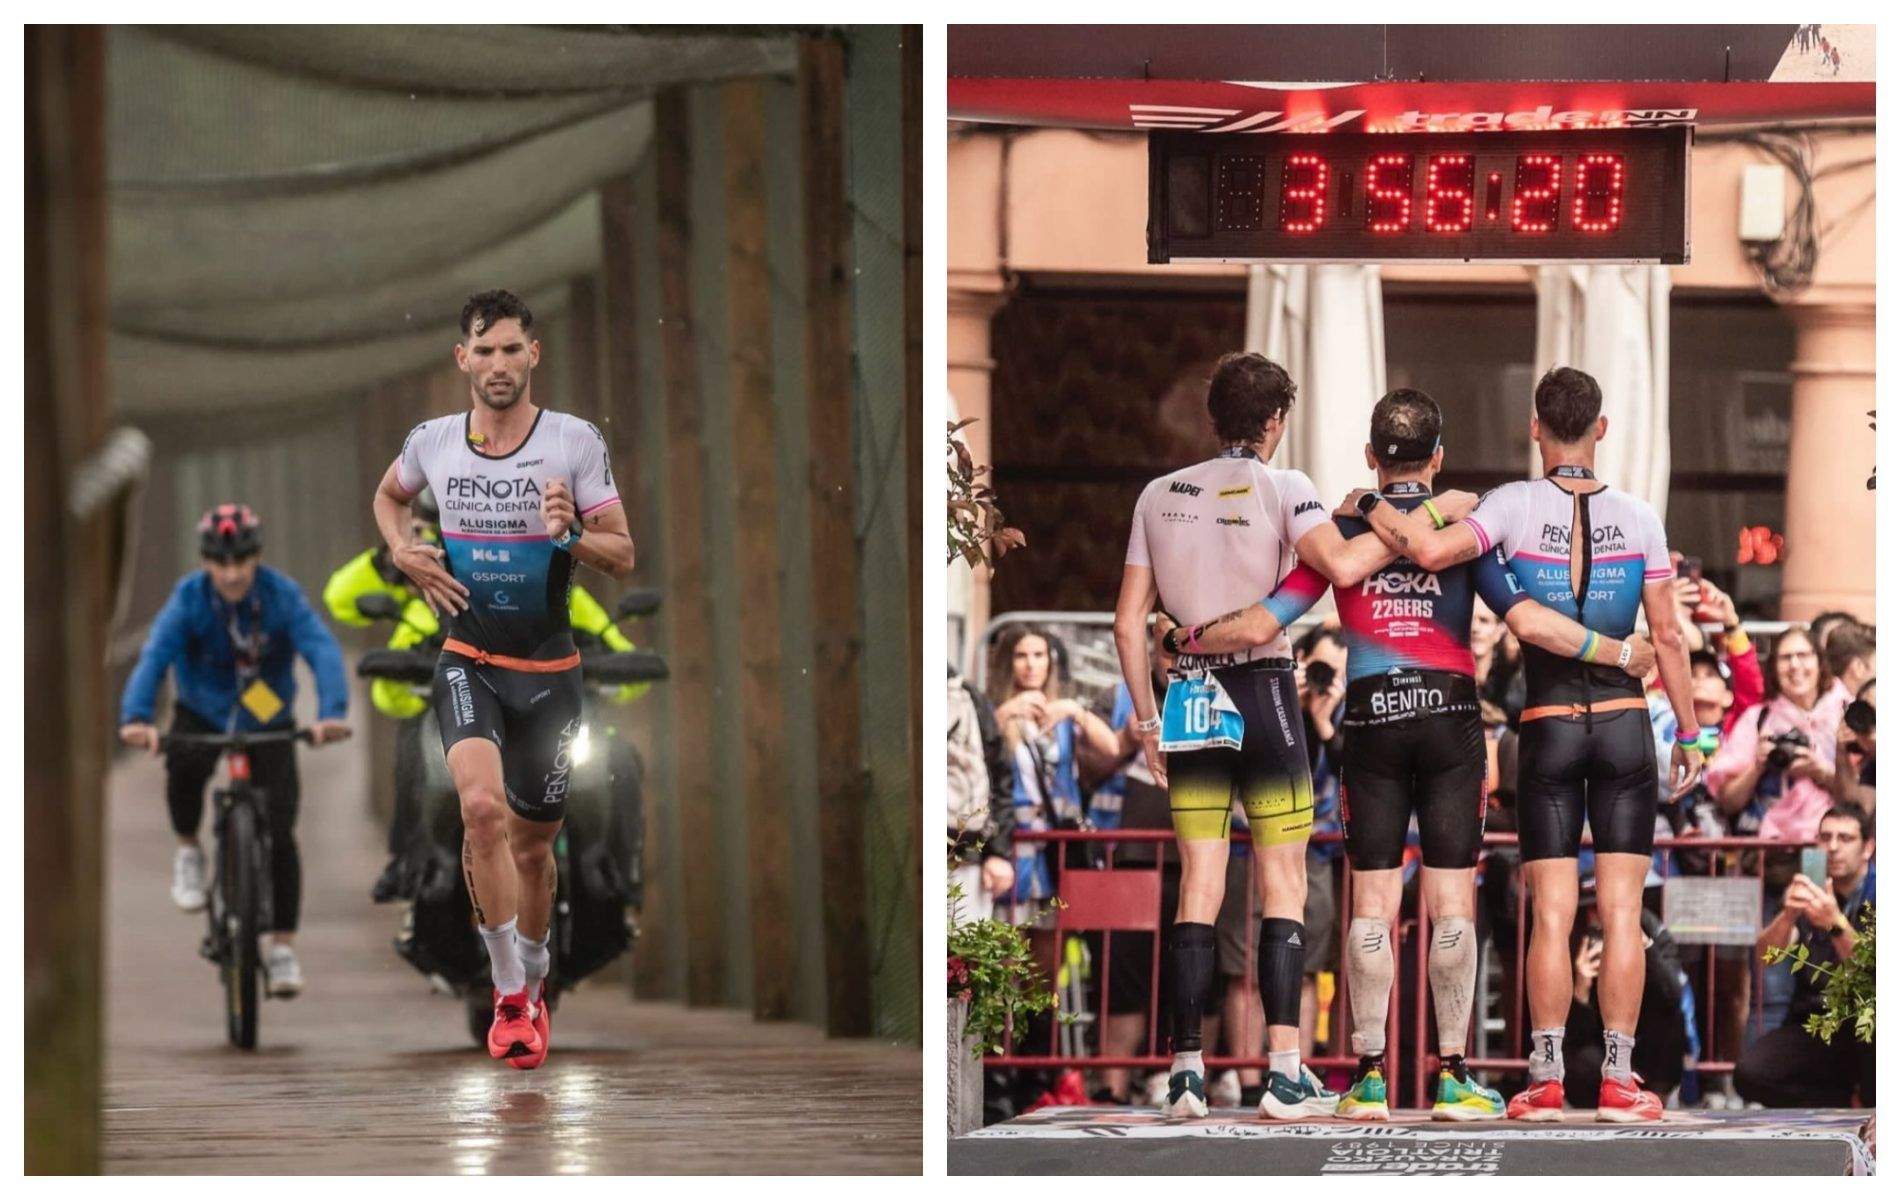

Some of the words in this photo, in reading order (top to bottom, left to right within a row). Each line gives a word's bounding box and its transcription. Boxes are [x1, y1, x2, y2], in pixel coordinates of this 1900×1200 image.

[446, 475, 541, 499] PEÑOTA
[1168, 481, 1202, 497] MAPEI
[445, 499, 493, 512] CLÍNICA
[459, 518, 528, 529] ALUSIGMA
[1594, 543, 1627, 555] DENTAL
[472, 571, 527, 583] GSPORT
[1361, 572, 1443, 597] HOKA
[1372, 598, 1434, 620] 226ERS
[1370, 688, 1444, 715] BENITO
[1183, 696, 1222, 734] 104
[543, 718, 575, 804] PEÑOTA
[1331, 1148, 1503, 1156] TRIATLOIA
